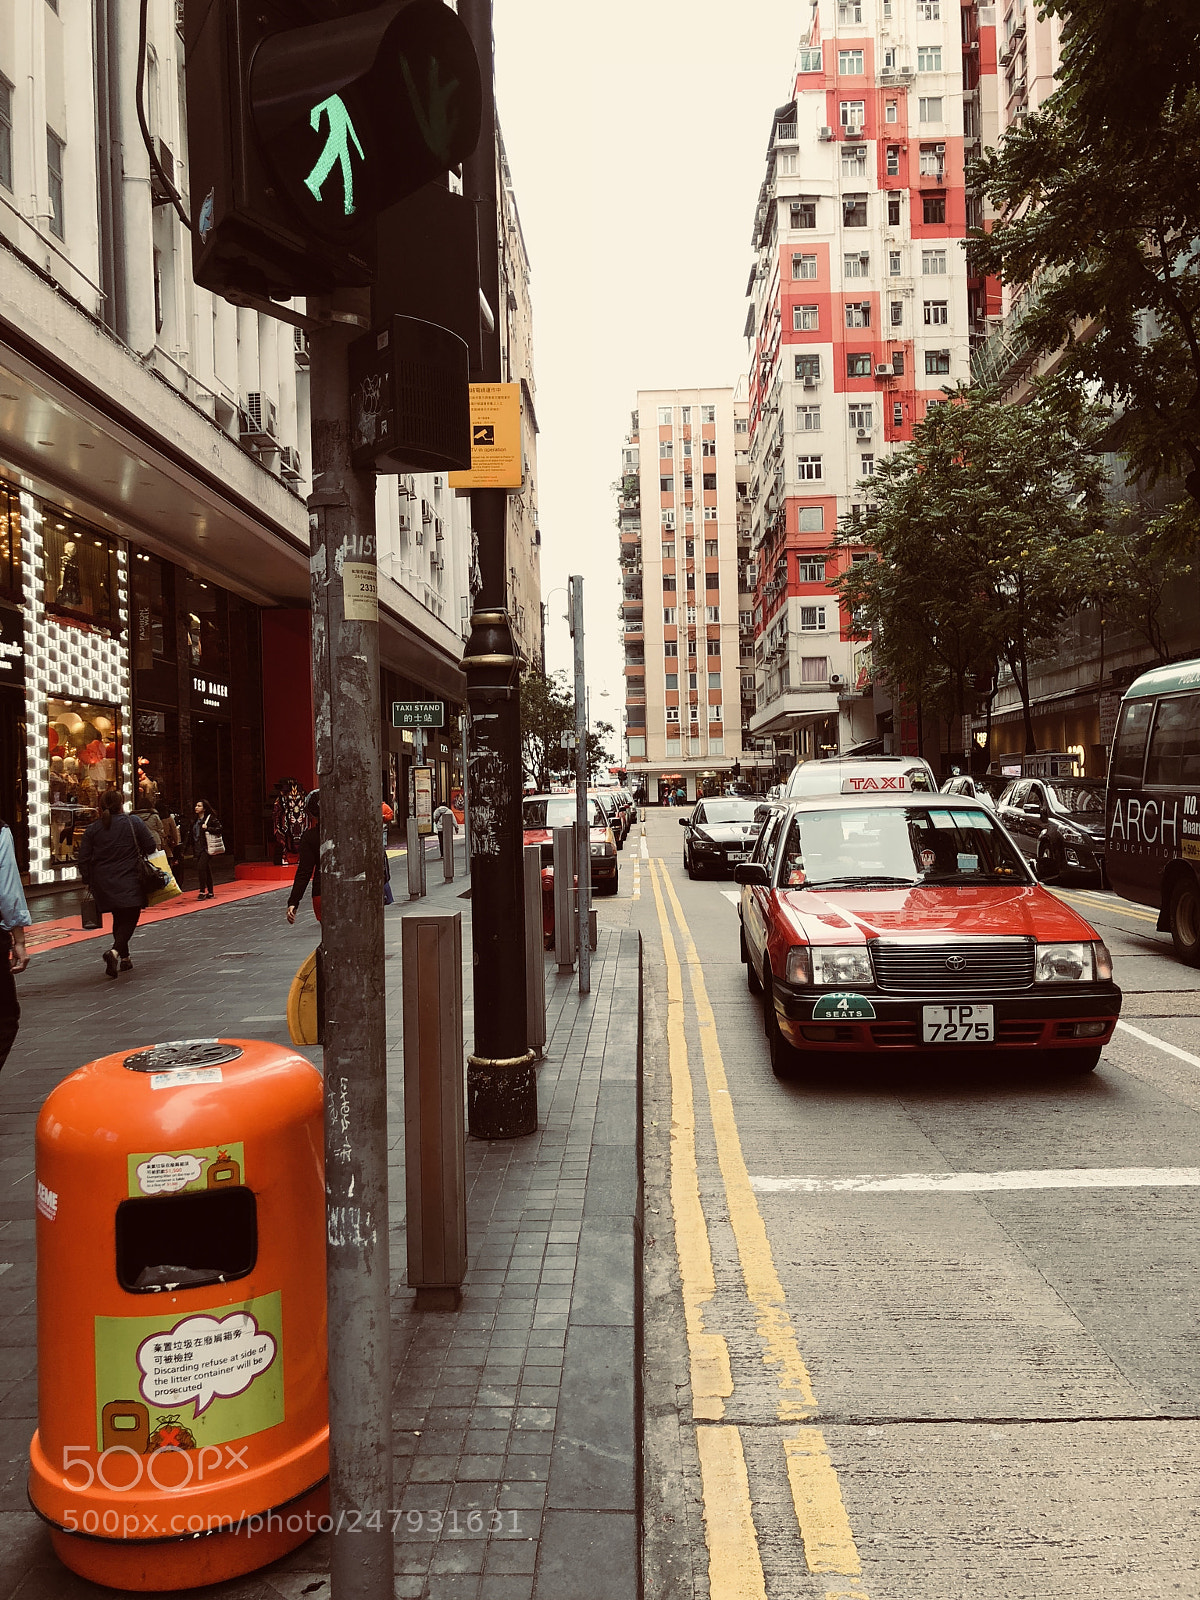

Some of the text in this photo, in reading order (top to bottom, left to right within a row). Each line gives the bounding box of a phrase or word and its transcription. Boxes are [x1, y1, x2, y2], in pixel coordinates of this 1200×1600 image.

[193, 678, 228, 698] TED BAKER
[403, 714, 432, 723] 的士站
[850, 777, 905, 790] TAXI
[1184, 796, 1198, 815] NO.
[1110, 798, 1178, 846] ARCH
[1110, 841, 1178, 860] EDUCATION
[837, 998, 849, 1010] 4
[943, 1006, 974, 1023] TP
[928, 1023, 989, 1041] 7275
[154, 1351, 193, 1364] 可被檢控
[154, 1363, 199, 1375] Discarding
[202, 1356, 228, 1368] refuse
[241, 1348, 256, 1359] side
[258, 1343, 267, 1353] of
[154, 1357, 263, 1386] the litter container will be
[154, 1382, 202, 1397] prosecuted
